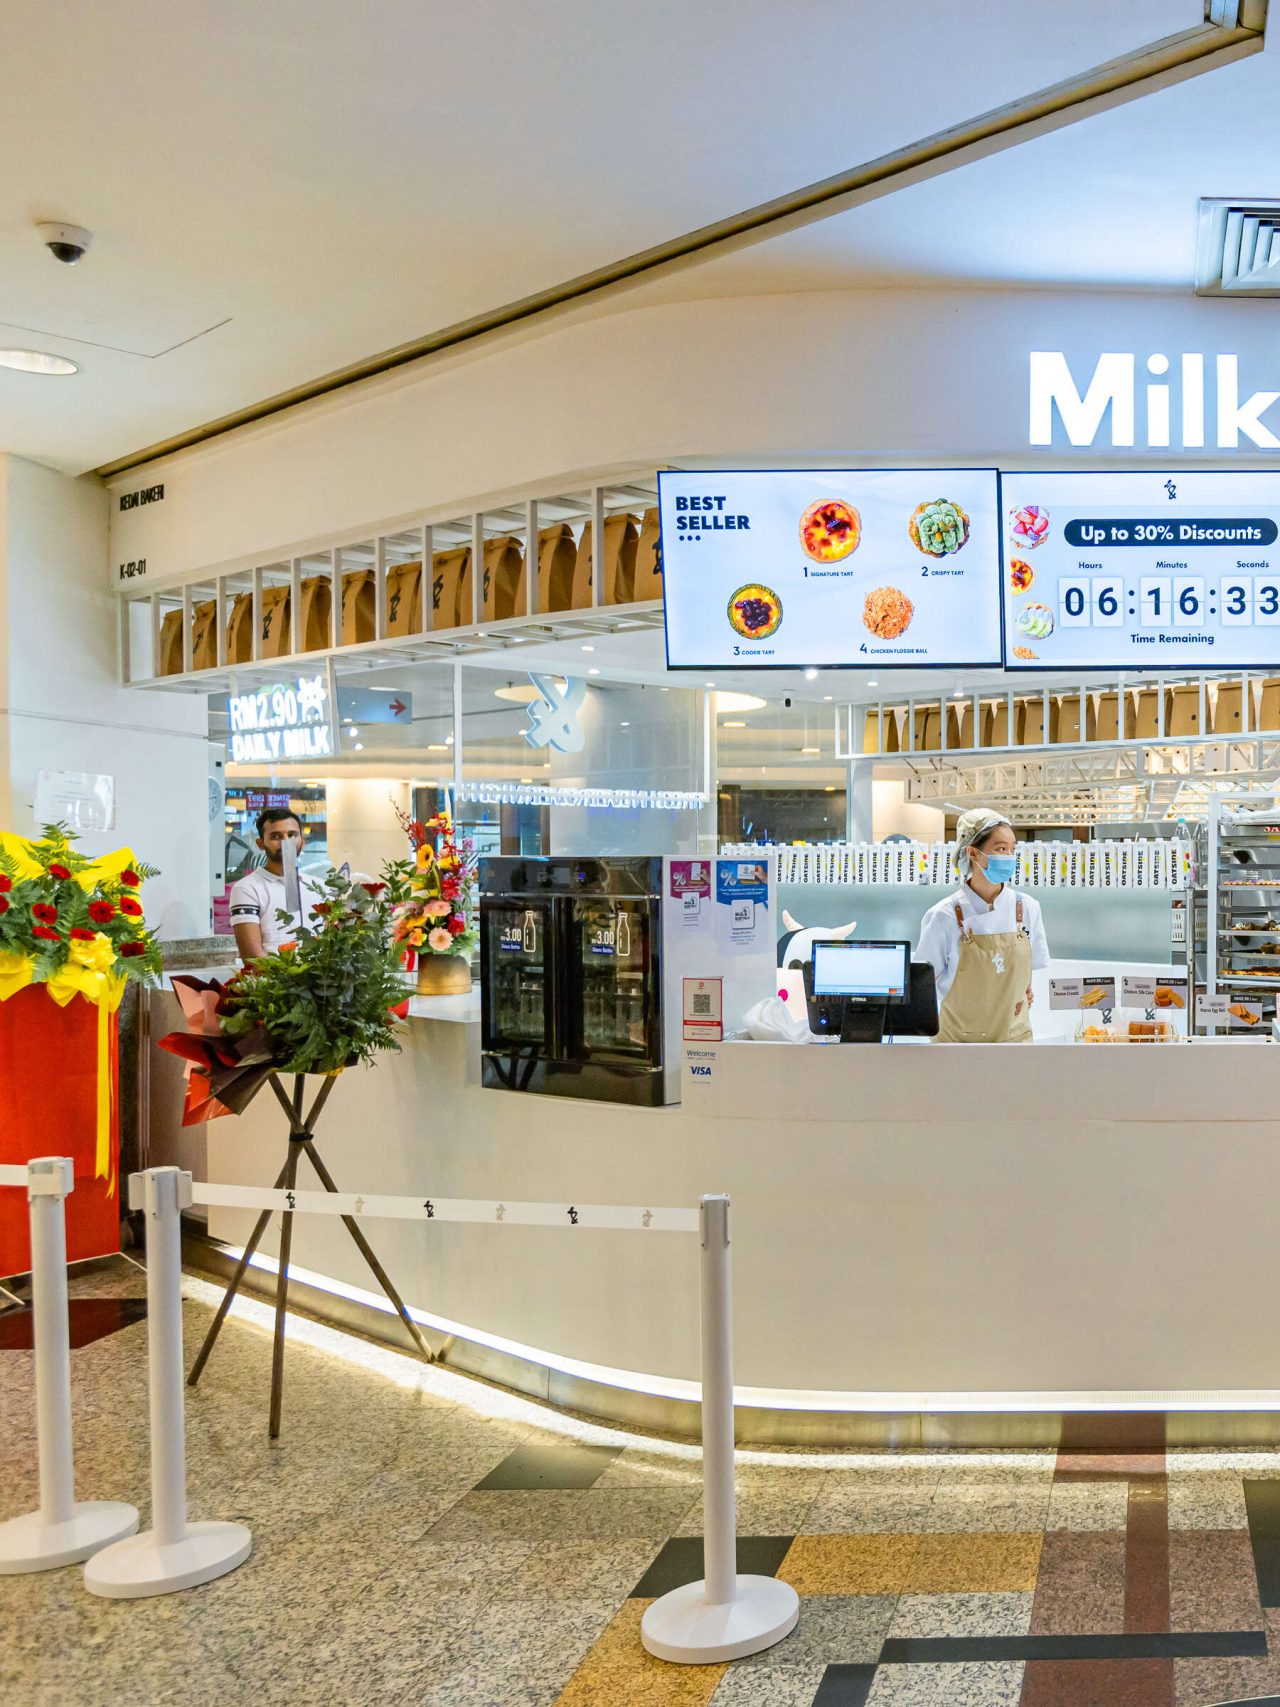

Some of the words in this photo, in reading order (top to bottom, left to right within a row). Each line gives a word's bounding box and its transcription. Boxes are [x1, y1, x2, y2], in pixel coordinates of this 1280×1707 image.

[120, 492, 139, 511] KEDAI
[140, 484, 164, 505] BAKERI
[676, 496, 726, 511] BEST
[676, 515, 751, 530] SELLER
[1081, 525, 1106, 544] Up
[1111, 526, 1129, 540] to
[1134, 525, 1174, 540] 30%
[1179, 524, 1262, 540] Discounts
[120, 558, 146, 580] K-02-01
[1078, 561, 1103, 570] Hours
[1156, 561, 1188, 569] Minutes
[1236, 560, 1270, 569] Seconds
[803, 566, 808, 578] 1
[921, 566, 929, 577] 2
[1130, 634, 1156, 644] Time
[1158, 634, 1215, 646] Remaining
[733, 646, 740, 656] 3
[859, 643, 868, 654] 4
[229, 689, 298, 731] RM2.90
[232, 731, 281, 761] DAILY
[283, 725, 330, 758] MILK
[686, 1050, 716, 1058] Welcome
[690, 1066, 712, 1076] VISA
